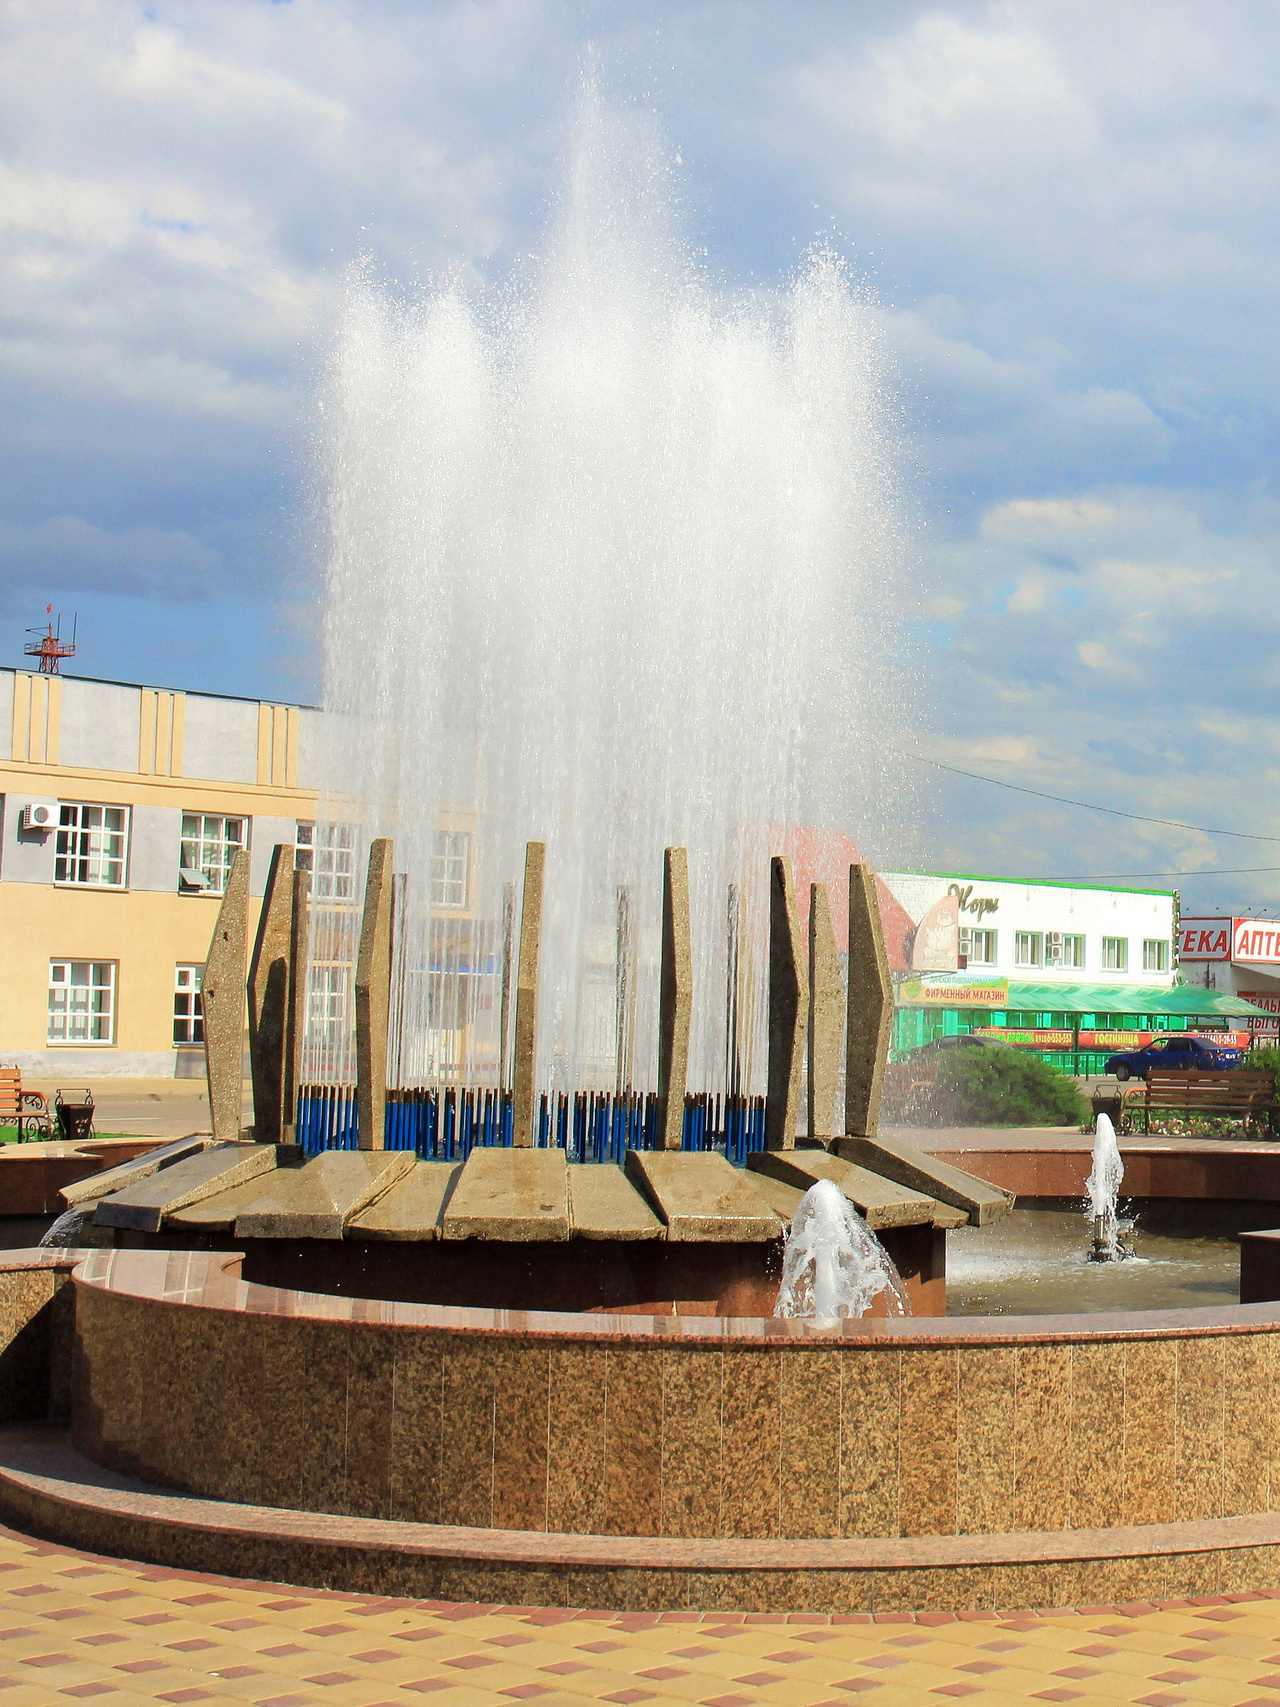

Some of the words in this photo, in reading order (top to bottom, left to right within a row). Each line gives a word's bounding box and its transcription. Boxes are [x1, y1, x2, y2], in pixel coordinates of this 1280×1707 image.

[1179, 930, 1227, 952] ЕКА
[925, 988, 971, 1000] ФИРМЕННЫЙ
[973, 990, 1005, 1000] МАГАЗИН
[1095, 1034, 1139, 1044] ГОСТИНИЦА
